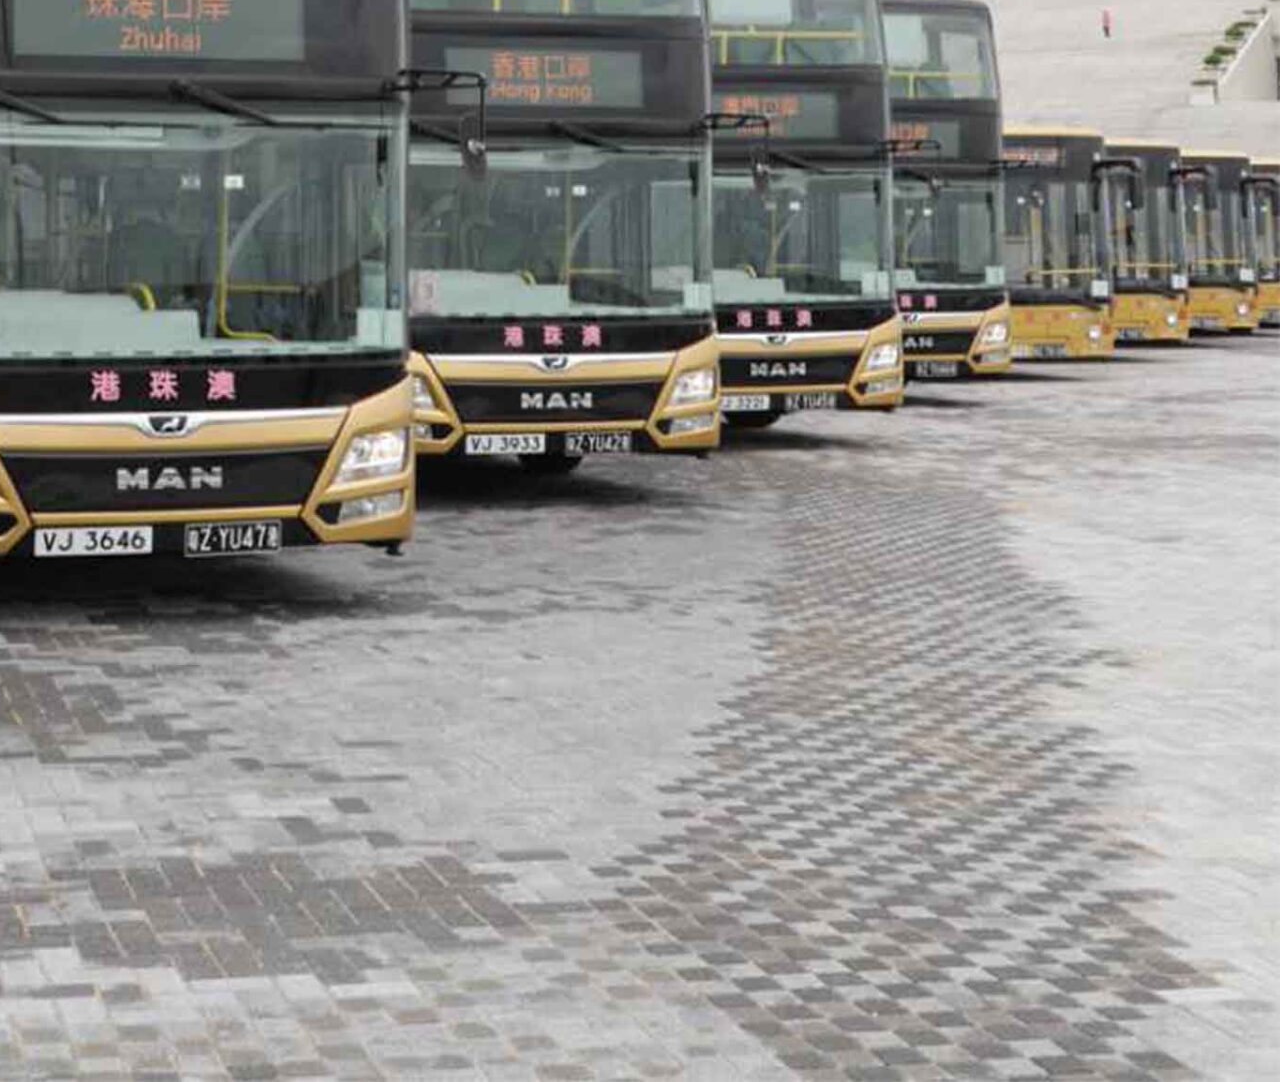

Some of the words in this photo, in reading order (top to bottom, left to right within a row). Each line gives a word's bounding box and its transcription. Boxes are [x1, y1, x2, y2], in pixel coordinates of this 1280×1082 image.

[120, 25, 201, 53] Zhuhai
[903, 336, 935, 349] AN
[749, 361, 806, 377] MAN
[521, 392, 592, 409] MAN
[116, 466, 223, 490] MAN
[42, 531, 73, 552] VJ
[84, 530, 146, 551] 3646
